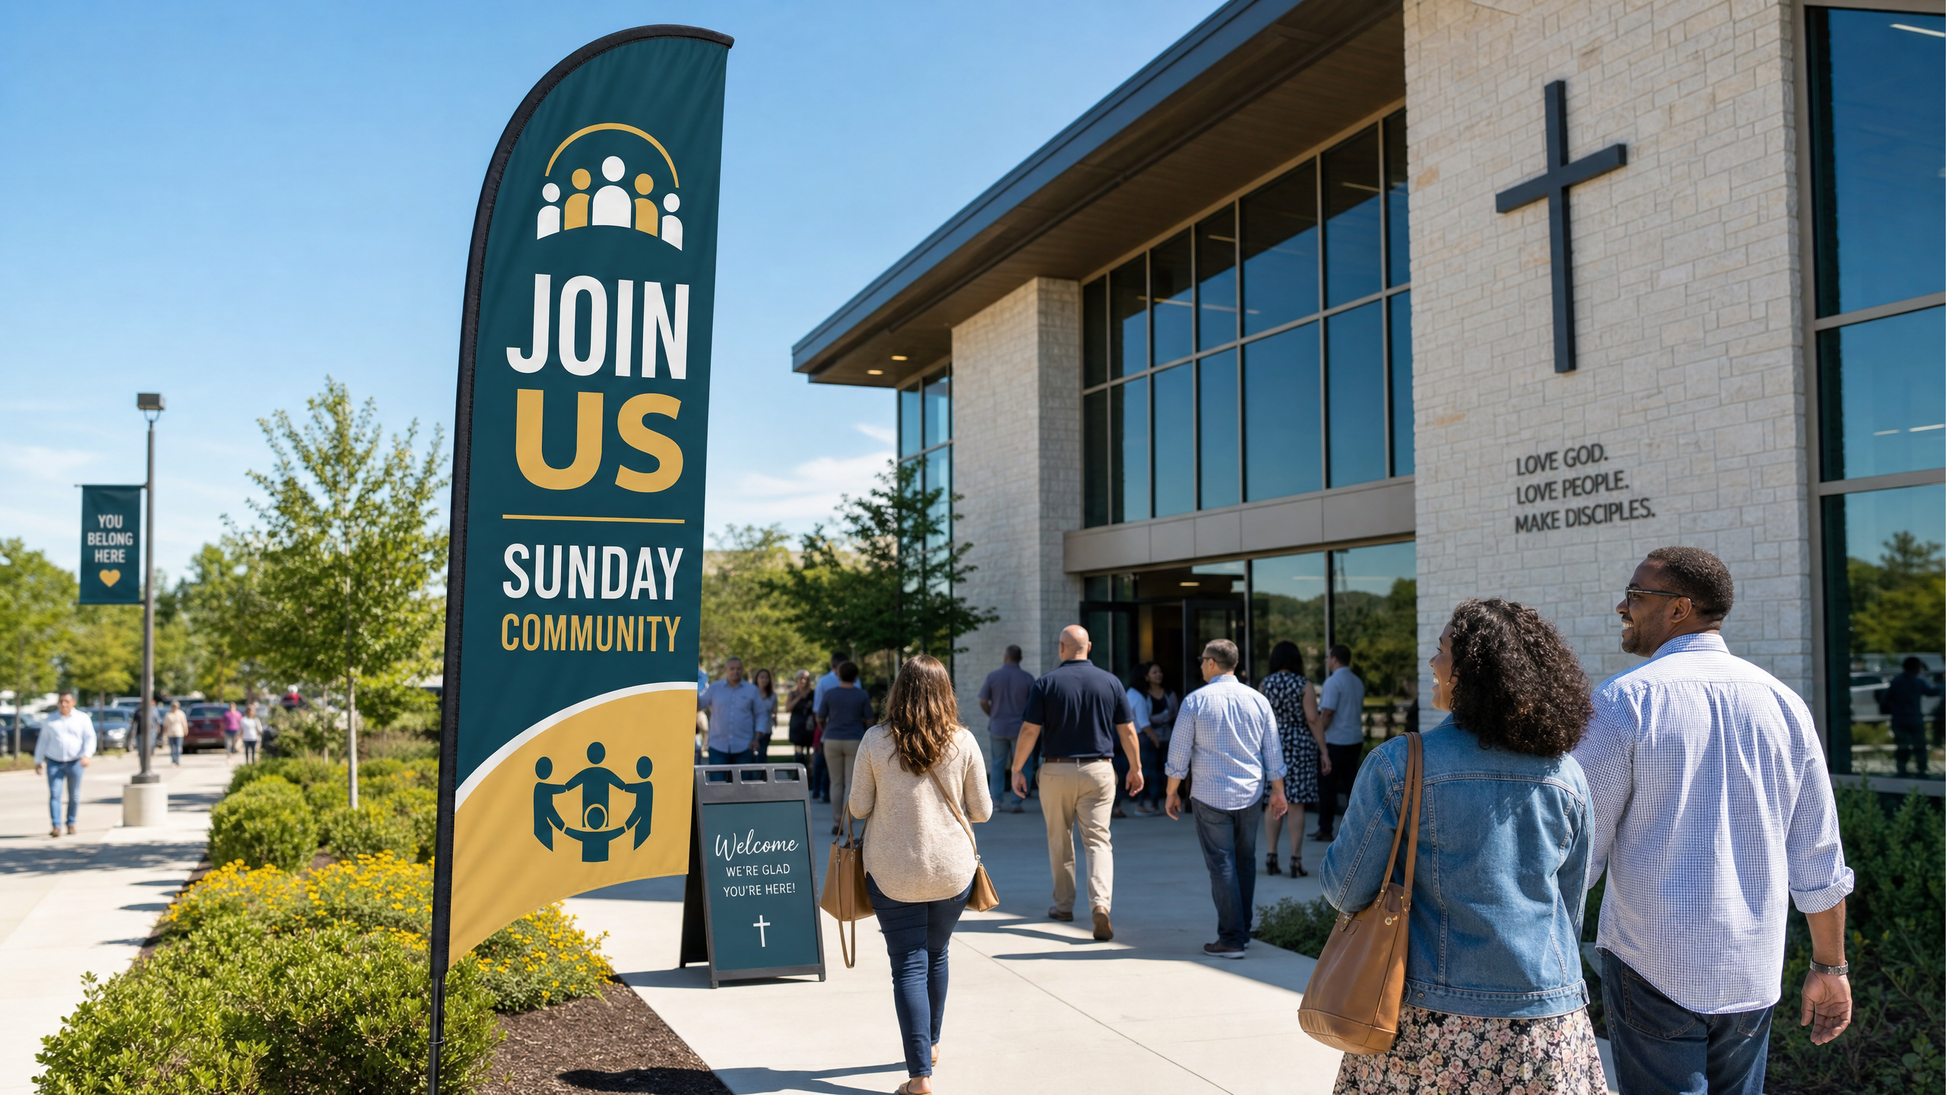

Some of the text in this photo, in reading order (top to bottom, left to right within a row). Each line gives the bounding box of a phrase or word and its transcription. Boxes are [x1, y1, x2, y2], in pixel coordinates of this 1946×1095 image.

[506, 273, 689, 380] JOIN
[515, 388, 684, 493] US
[1516, 443, 1608, 476] LOVE GOD.
[1516, 470, 1629, 505] LOVE PEOPLE.
[97, 514, 123, 529] YOU
[1515, 498, 1656, 534] MAKE DISCIPLES.
[87, 532, 133, 546] BELONG
[94, 549, 126, 563] HERE
[502, 543, 684, 600] SUNDAY
[501, 613, 681, 652] COMMUNITY
[715, 828, 799, 861] Welcome
[725, 863, 790, 877] WE'RE GLAD
[723, 882, 796, 897] YOU'RE HERE!
